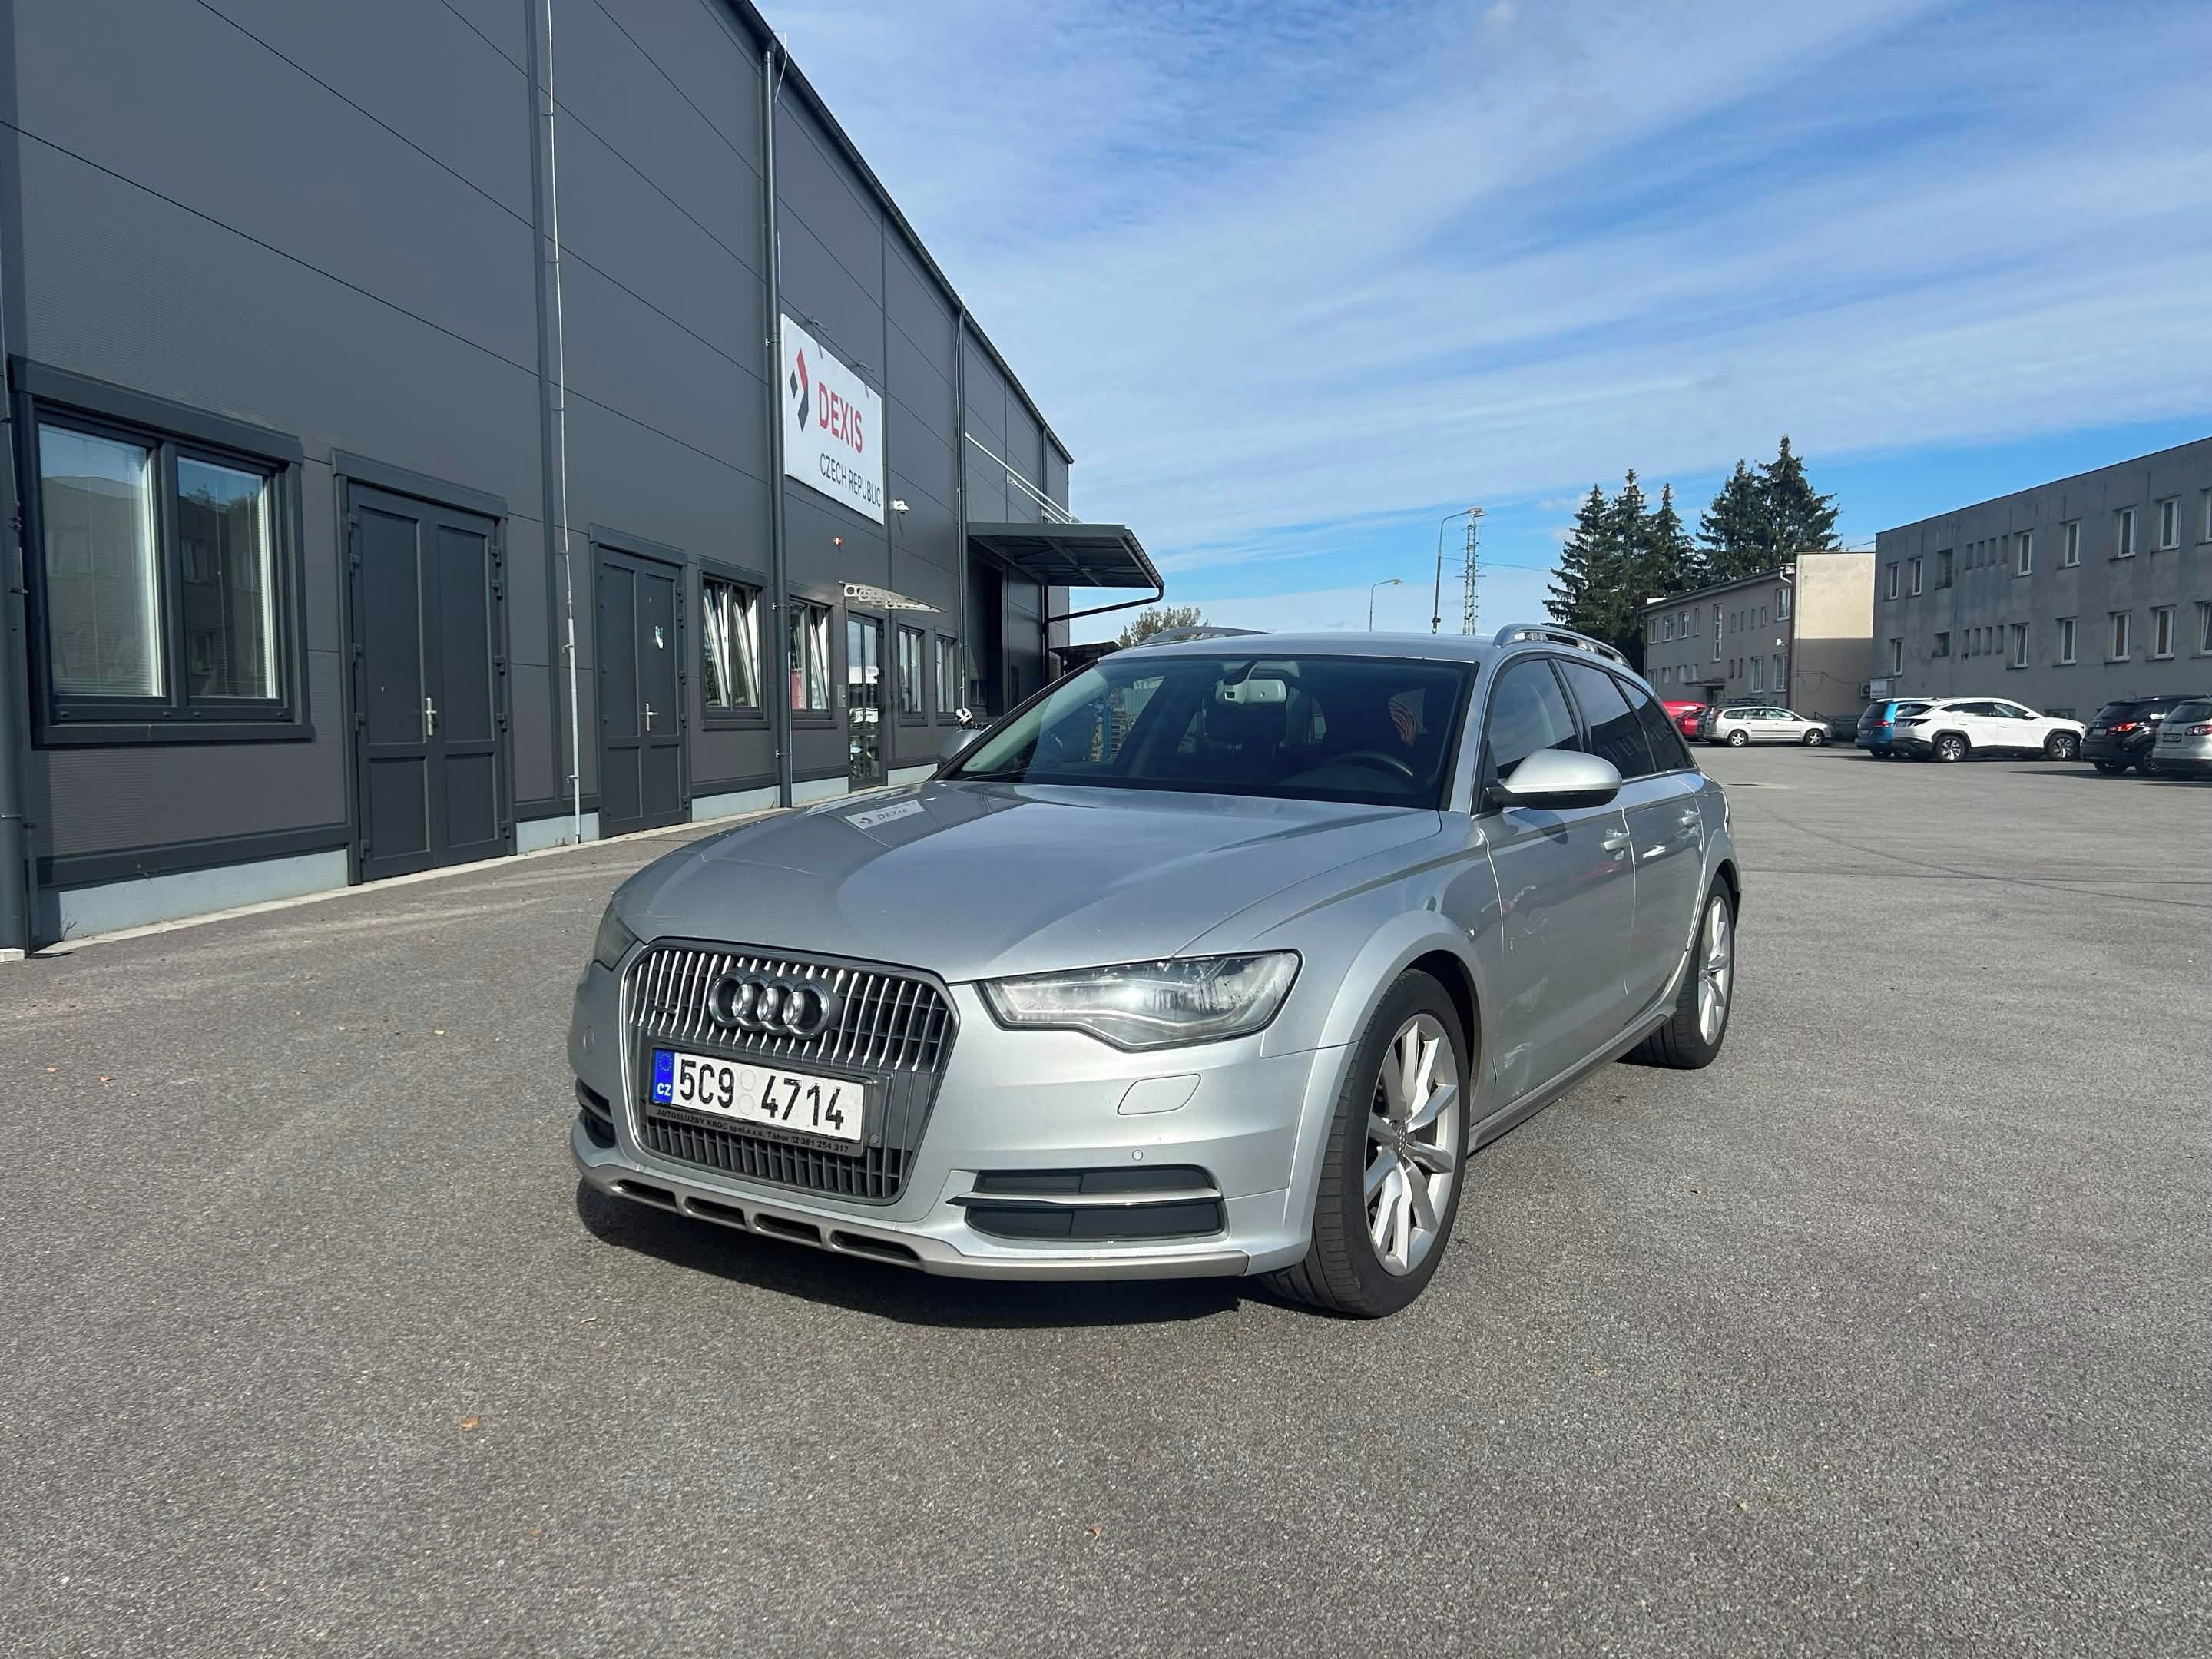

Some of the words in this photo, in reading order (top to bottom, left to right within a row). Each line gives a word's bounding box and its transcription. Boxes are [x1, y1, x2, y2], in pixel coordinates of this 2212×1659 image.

[817, 381, 863, 454] DEXIS
[820, 452, 847, 488] CZECH
[849, 469, 881, 507] REPUBLIC
[657, 1082, 671, 1096] CZ
[680, 1058, 735, 1108] 5C9
[761, 1075, 844, 1131] 4714
[817, 1141, 832, 1150] 254
[834, 1144, 849, 1153] 317
